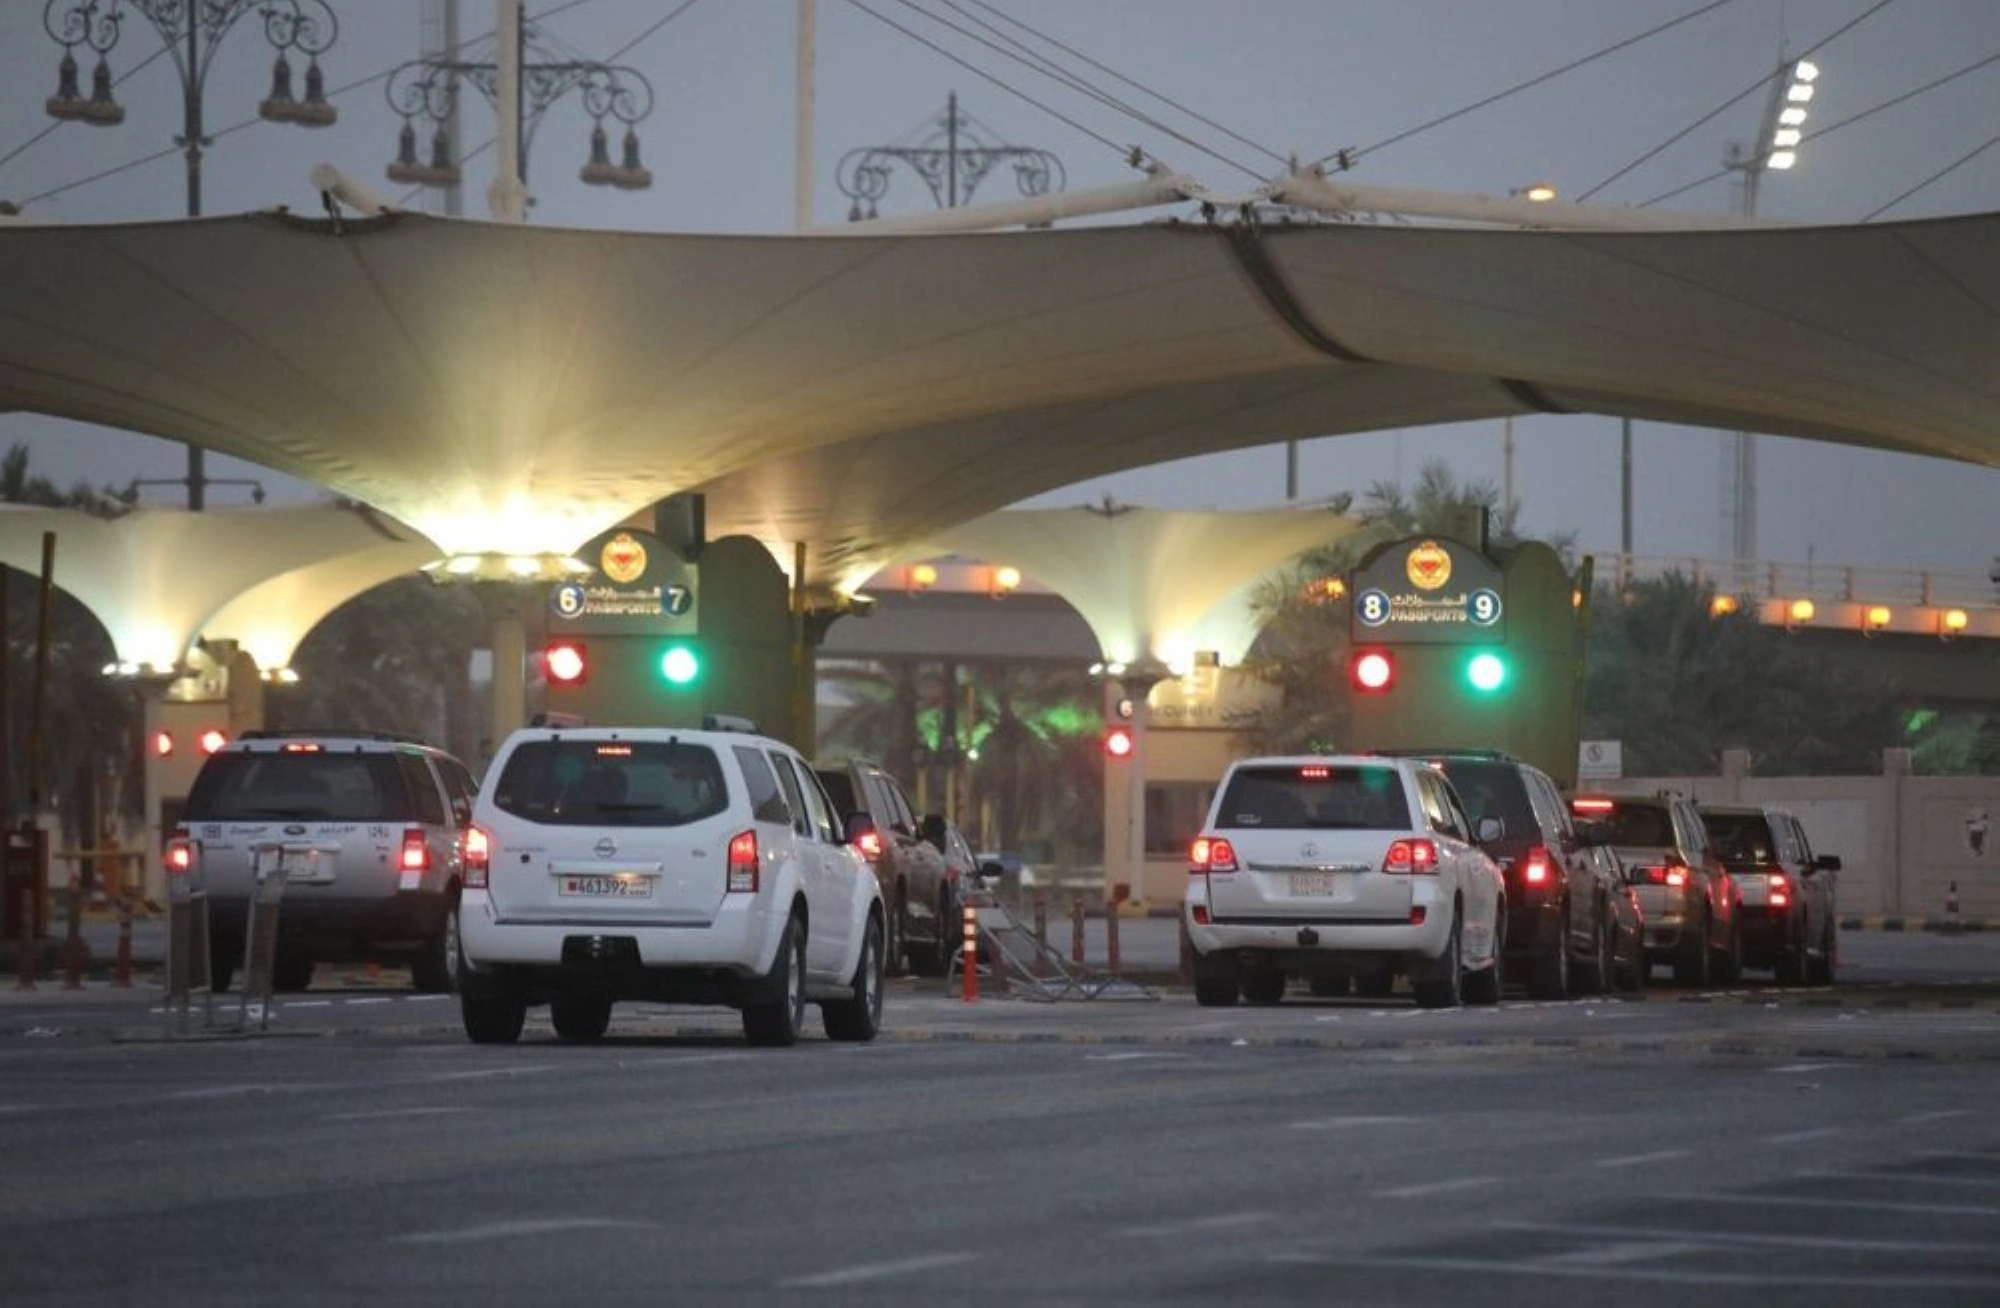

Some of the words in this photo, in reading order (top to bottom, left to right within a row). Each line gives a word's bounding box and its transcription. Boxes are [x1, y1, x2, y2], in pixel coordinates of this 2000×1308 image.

[560, 588, 577, 612] 6
[668, 588, 685, 611] 7
[1364, 595, 1381, 619] 8
[1475, 595, 1493, 619] 9
